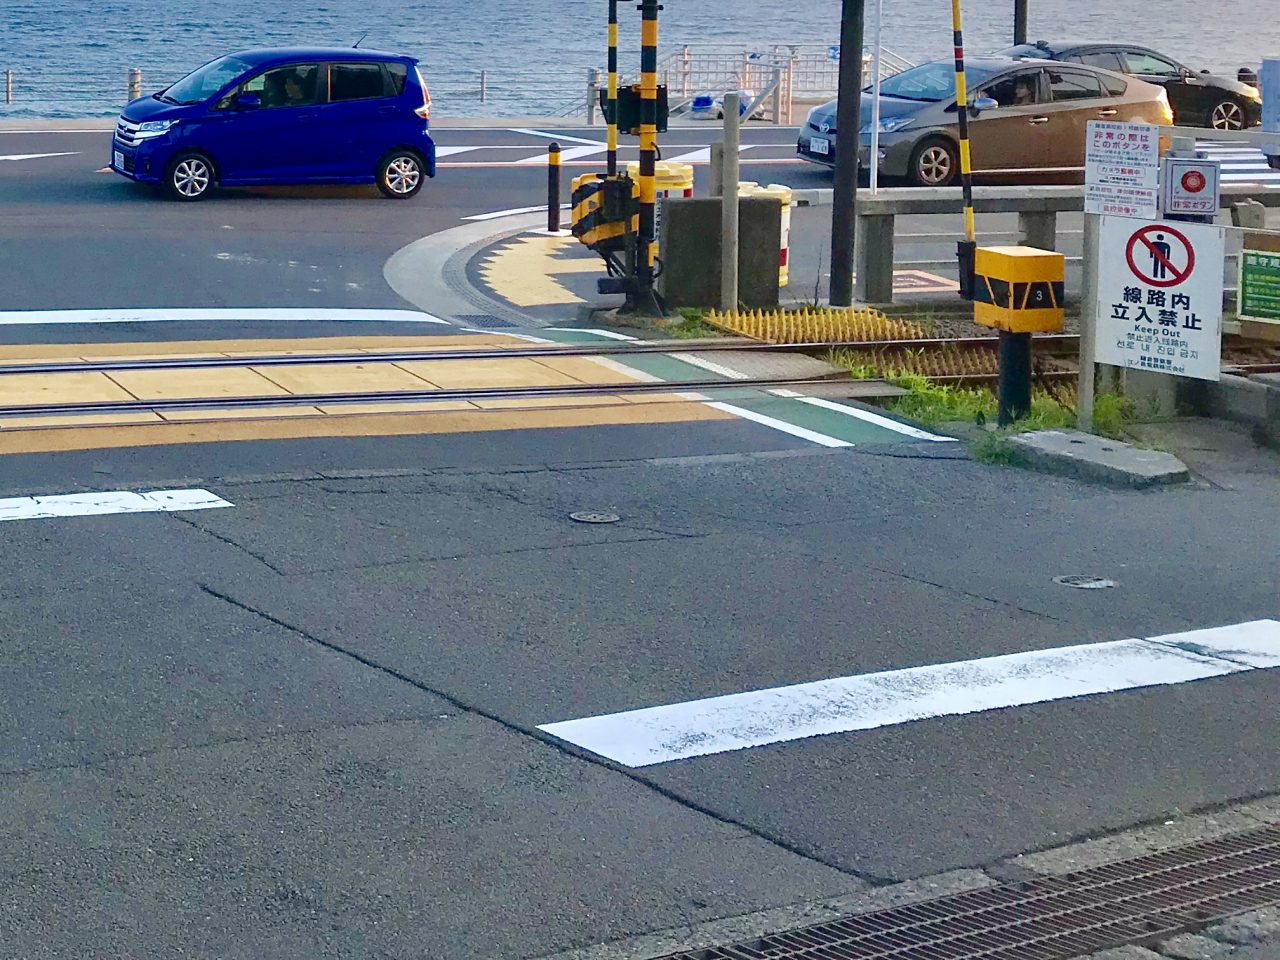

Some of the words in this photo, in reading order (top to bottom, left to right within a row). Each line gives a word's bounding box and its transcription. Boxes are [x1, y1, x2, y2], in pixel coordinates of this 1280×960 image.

[1094, 131, 1149, 142] 非常の際は
[1093, 140, 1150, 151] このボタンを
[1036, 290, 1043, 301] 3
[1123, 286, 1190, 311] 線路内
[1110, 303, 1202, 331] 立入禁止
[1134, 324, 1159, 336] Keep
[1161, 328, 1181, 338] Out
